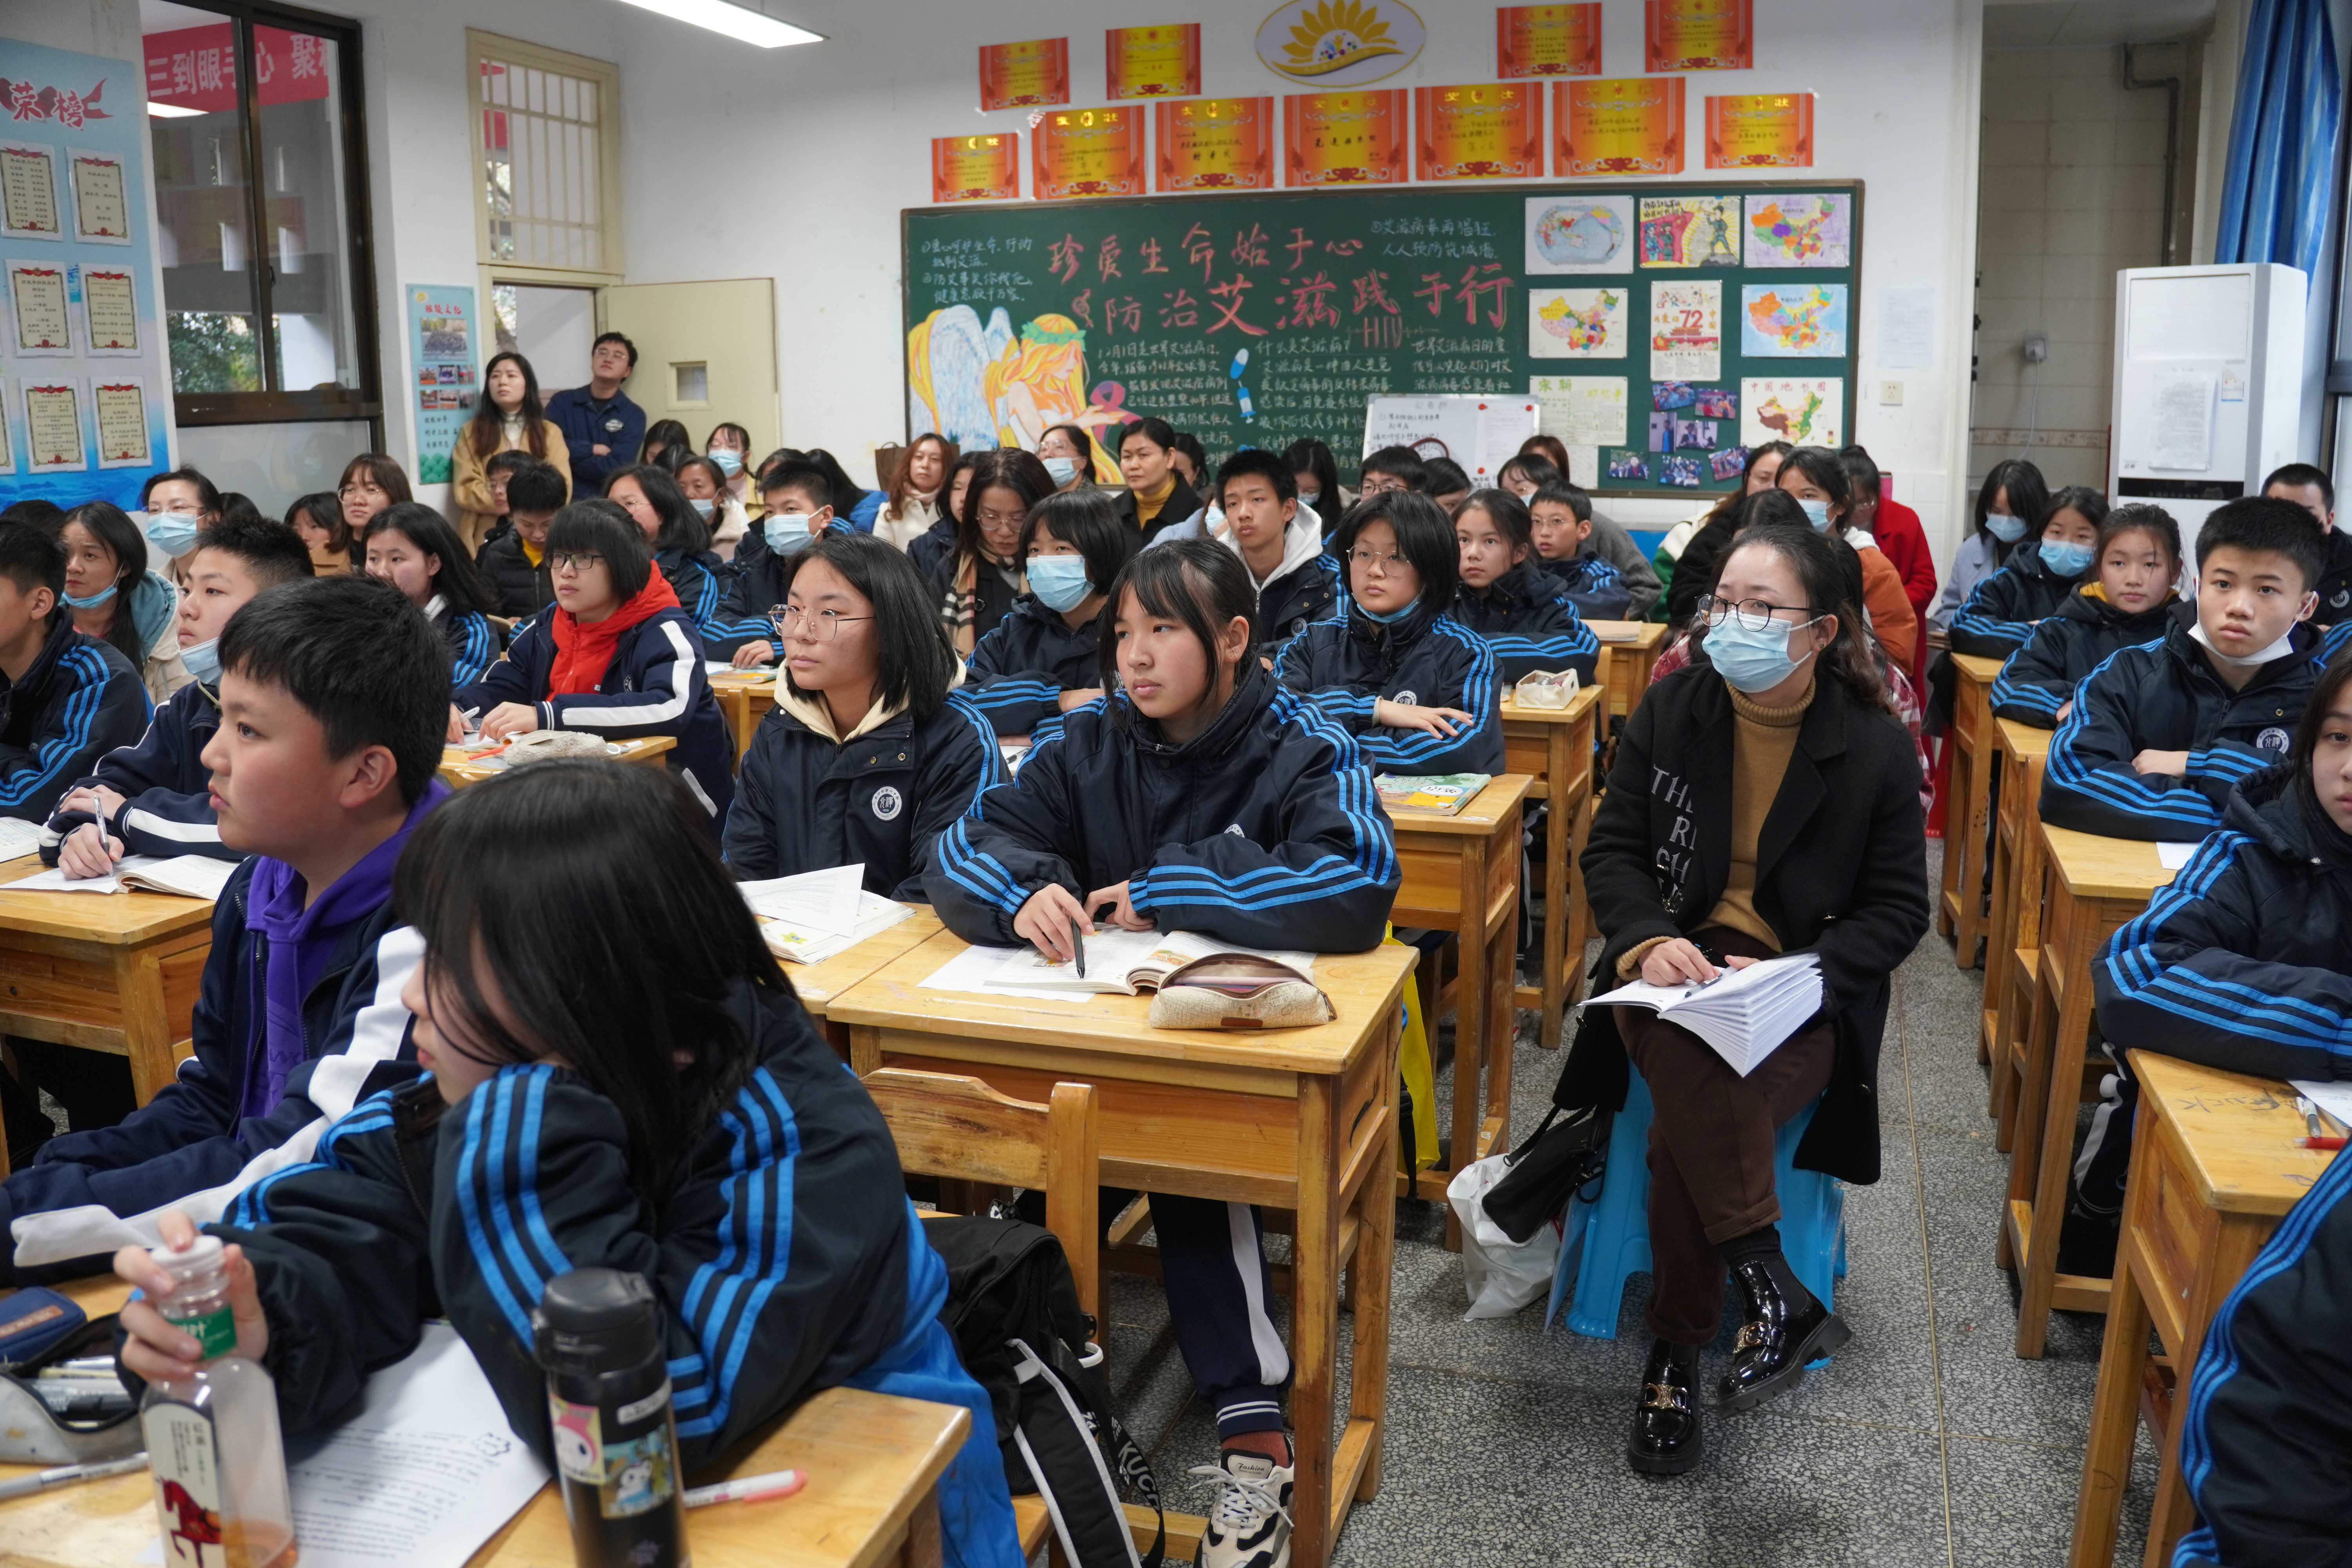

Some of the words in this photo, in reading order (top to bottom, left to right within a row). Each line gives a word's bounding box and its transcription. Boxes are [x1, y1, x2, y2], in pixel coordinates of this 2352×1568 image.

[1047, 221, 1363, 285] 珍爱生命始于心
[1105, 263, 1514, 336] 防治艾滋践于行
[425, 303, 462, 315] 班级文化
[1679, 310, 1703, 328] 72
[1539, 377, 1572, 393] 宋朝
[1751, 381, 1826, 392] 中国地形图
[1586, 387, 1622, 402] 那些事
[1236, 1463, 1265, 1472] Fashion
